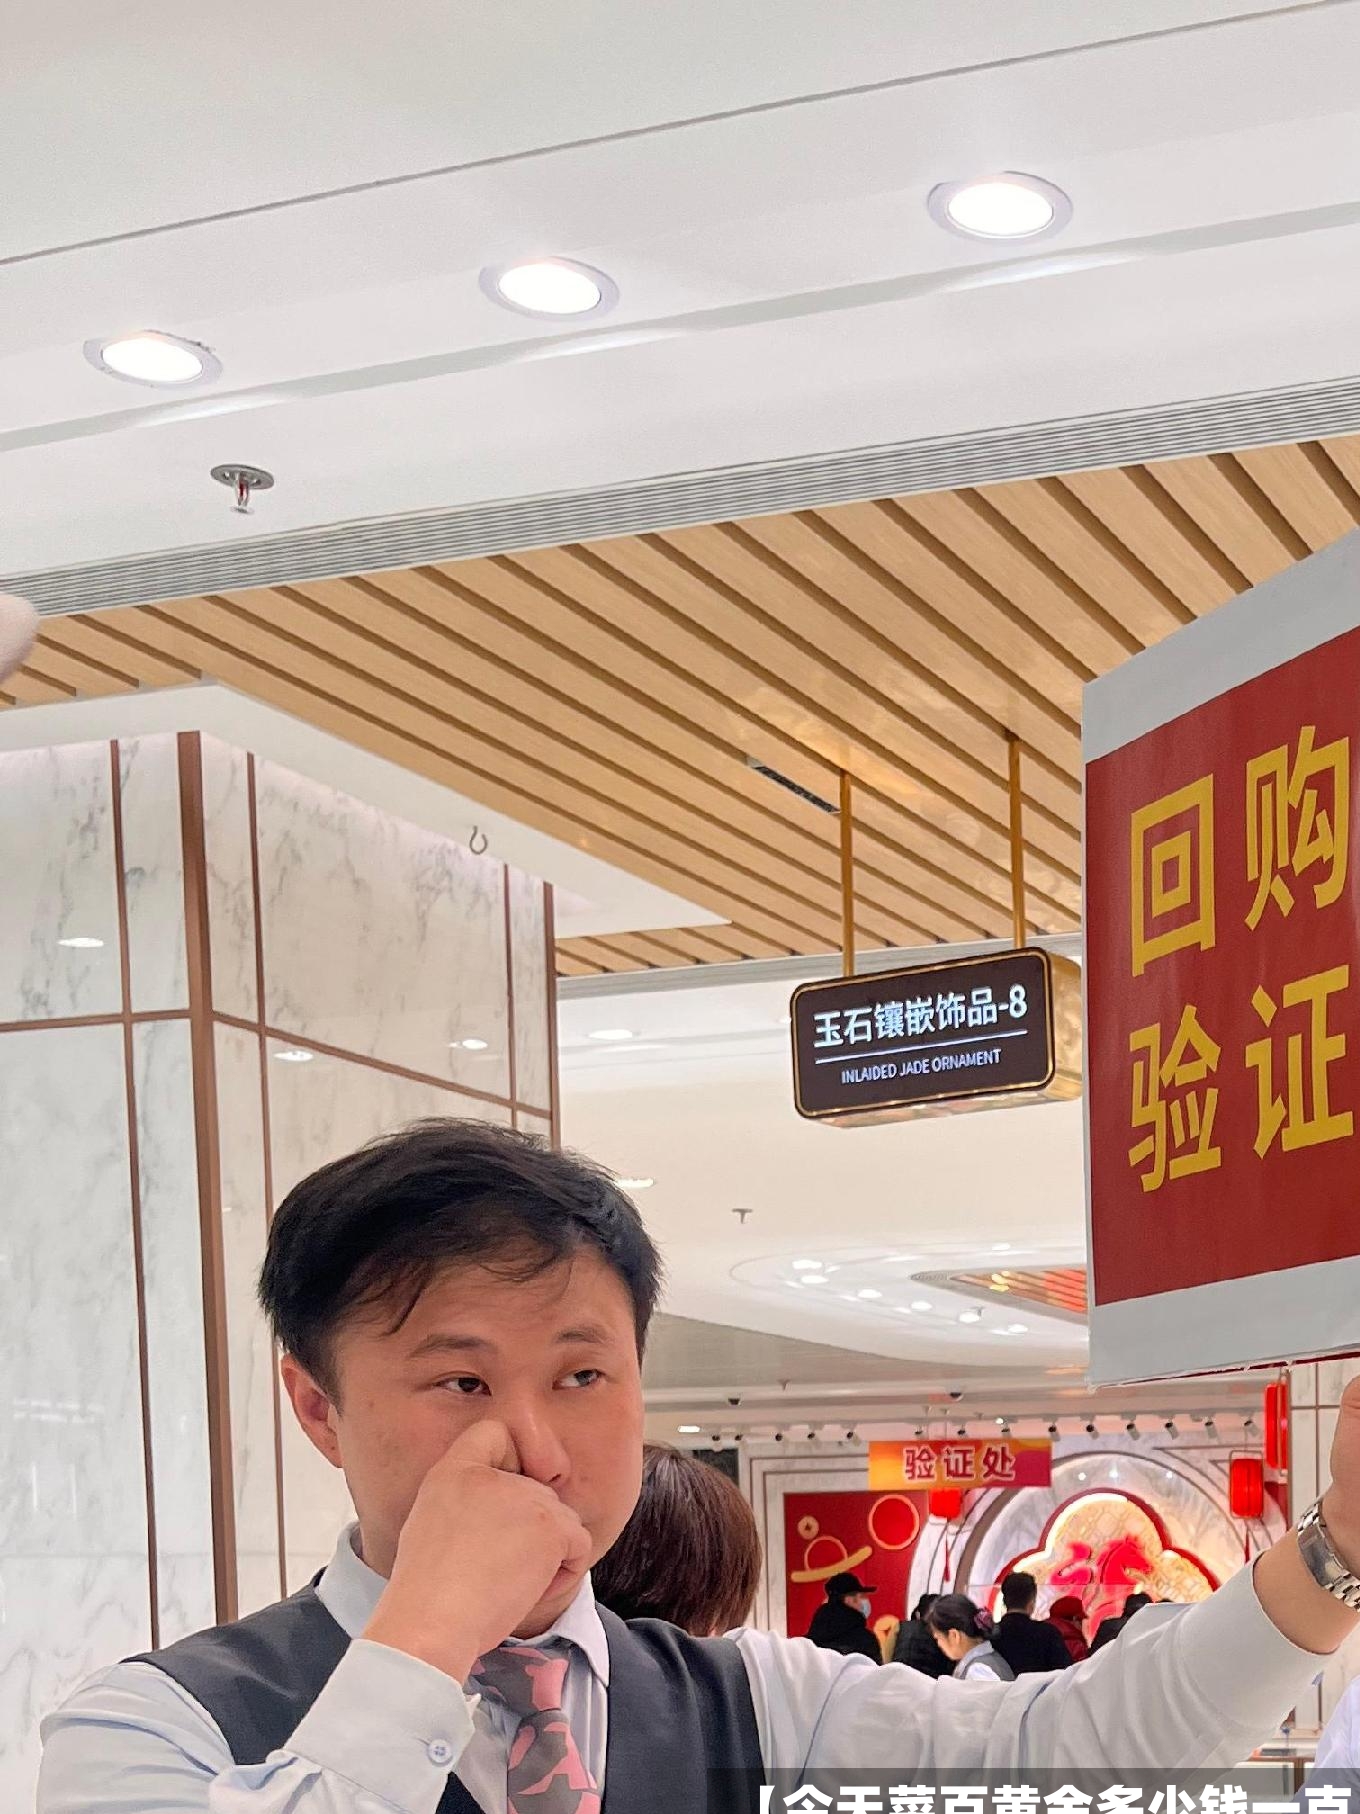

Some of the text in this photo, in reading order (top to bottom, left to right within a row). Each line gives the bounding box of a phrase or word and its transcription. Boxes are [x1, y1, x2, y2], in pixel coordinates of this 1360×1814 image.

[813, 983, 1028, 1048] 玉石镶嵌饰品-8
[841, 1048, 1002, 1084] INLAIDED JADE ORNAMENT
[903, 1443, 1016, 1481] 验证处
